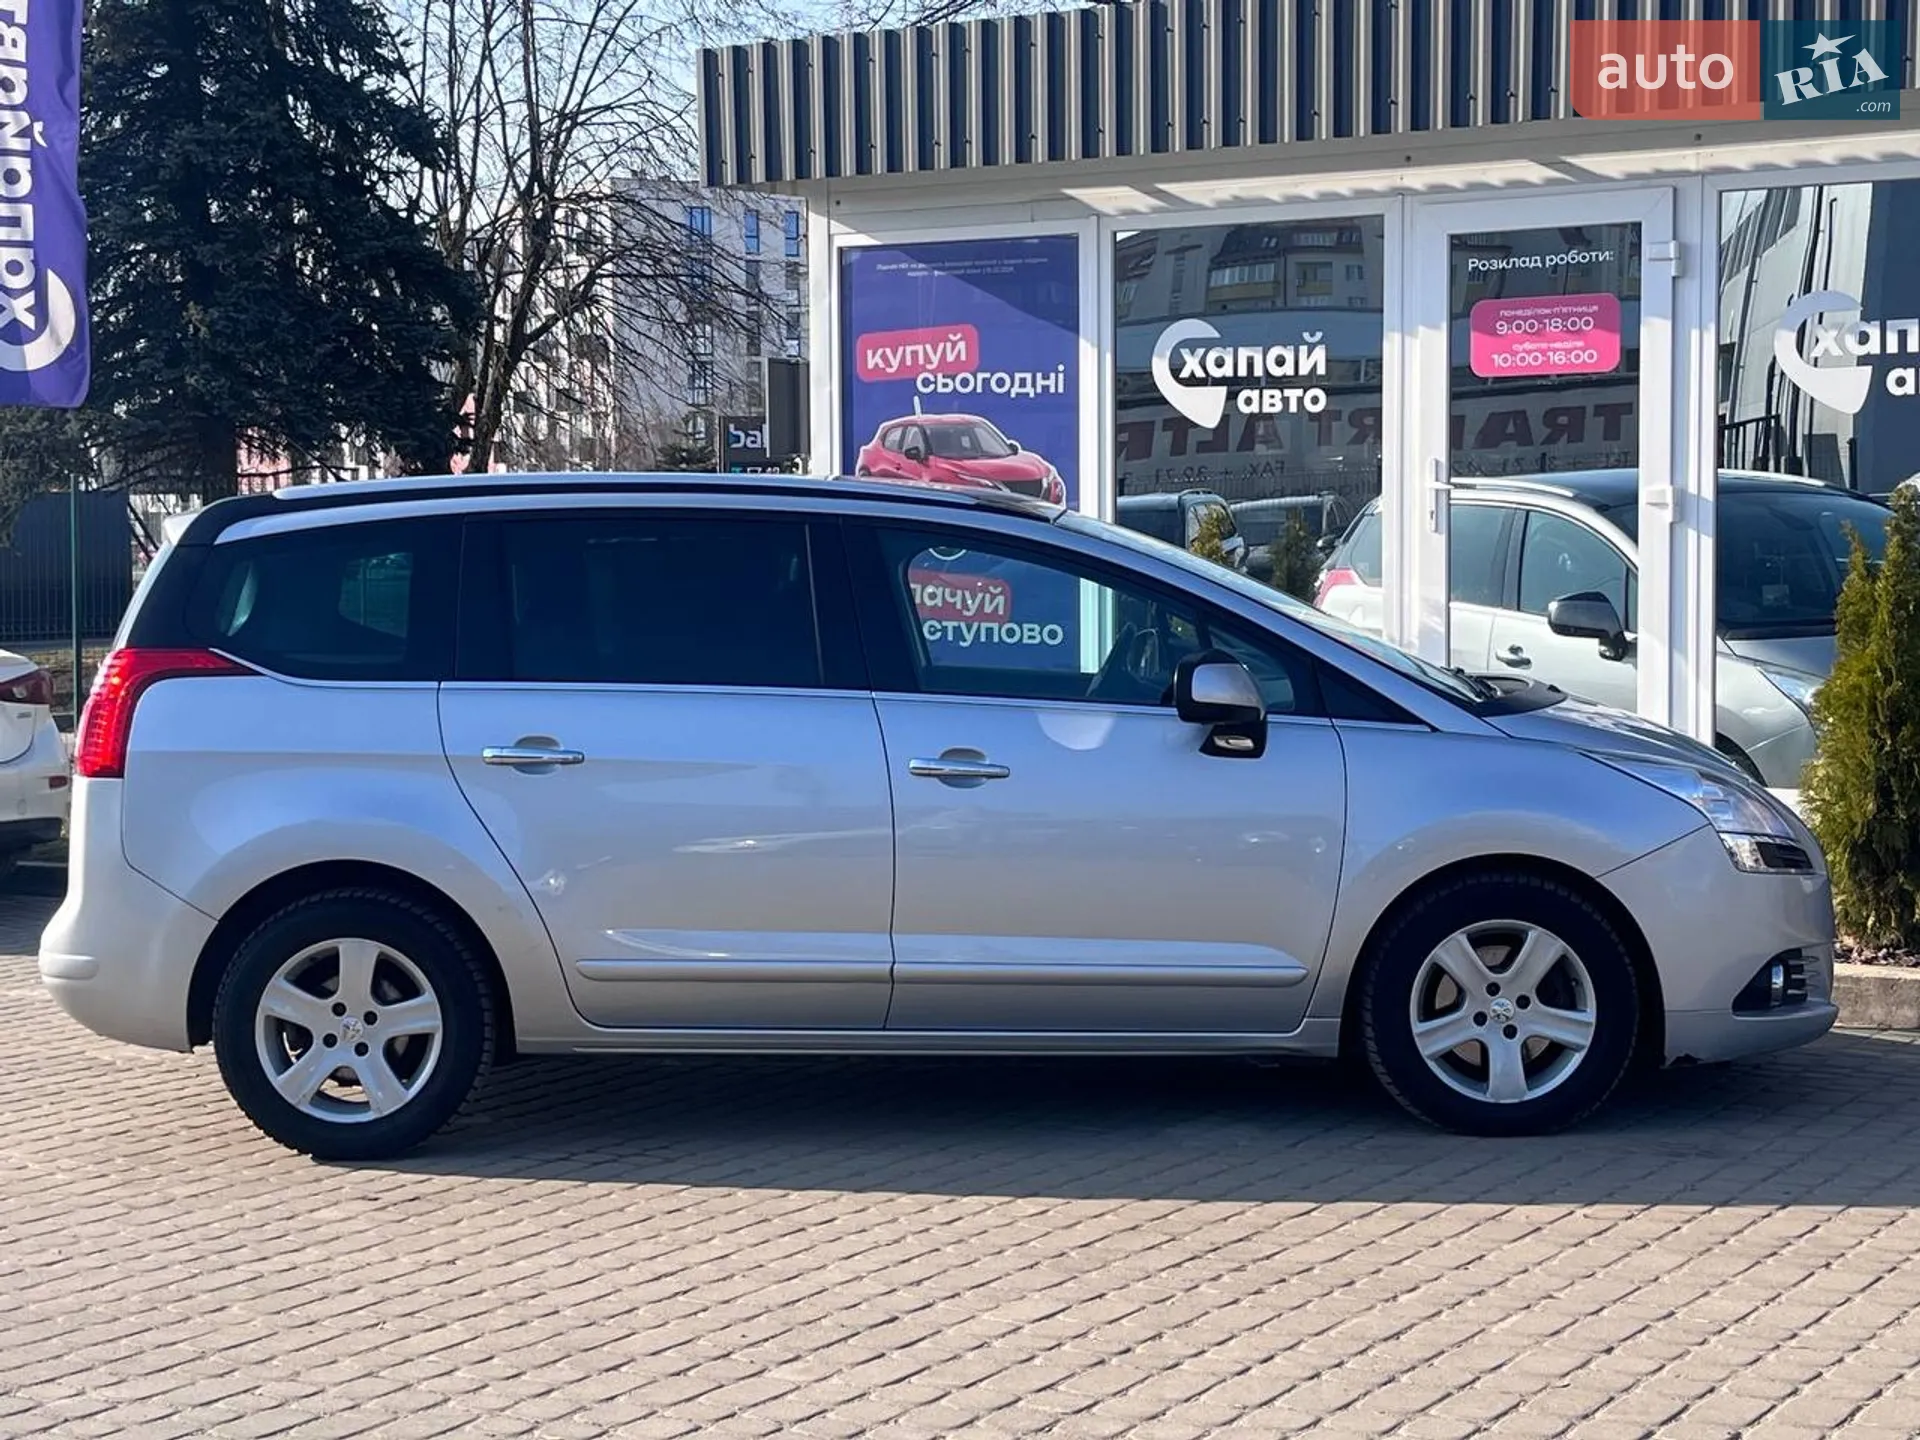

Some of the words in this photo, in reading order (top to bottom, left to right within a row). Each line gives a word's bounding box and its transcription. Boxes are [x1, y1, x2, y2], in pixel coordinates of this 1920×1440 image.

[1468, 255, 1542, 272] Розклад
[1545, 250, 1614, 268] роботи:
[1495, 316, 1595, 335] 9:00-18:00
[866, 332, 967, 374] купуй
[1178, 331, 1327, 379] хапай
[1491, 349, 1598, 368] 10:00-16:00
[915, 363, 1065, 399] сьогодні
[1236, 387, 1327, 414] авто
